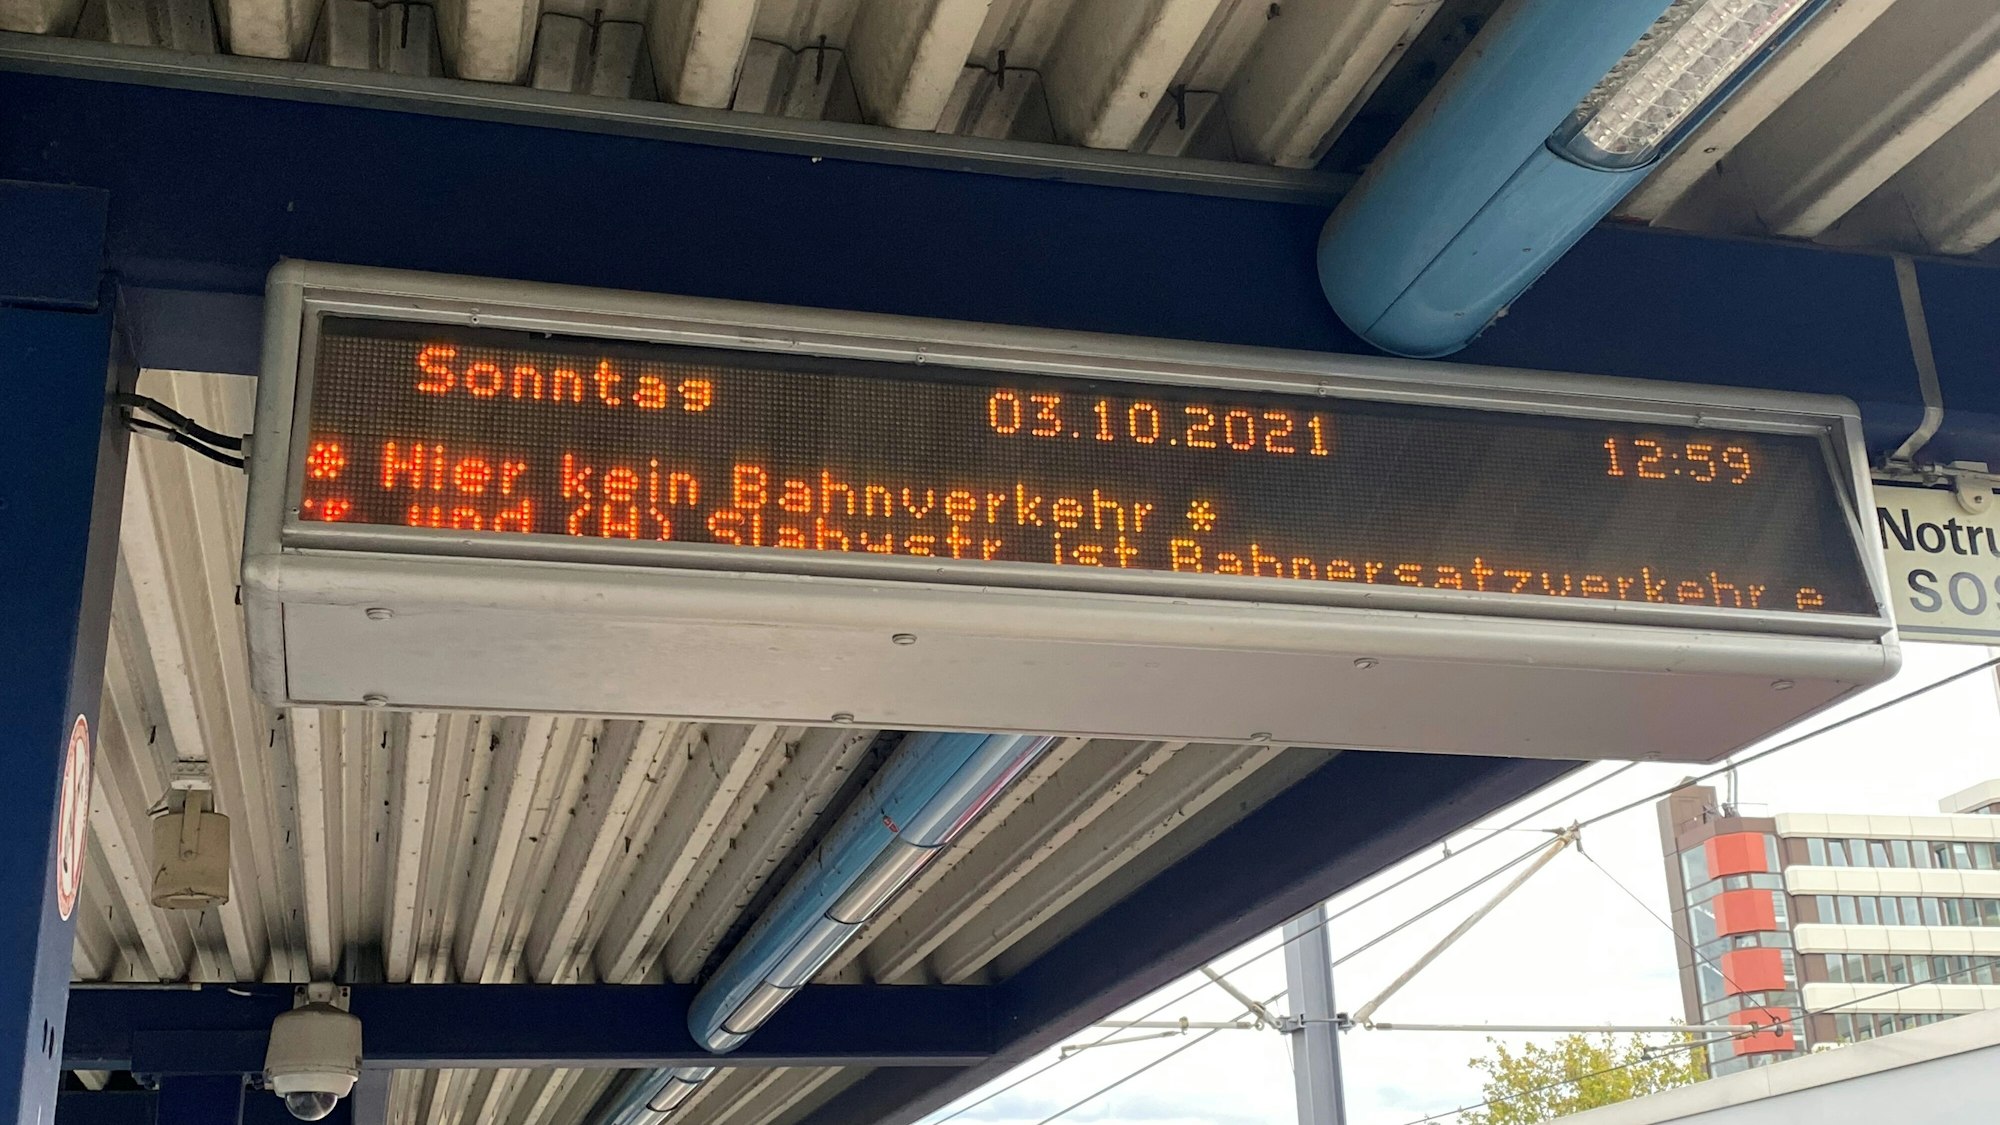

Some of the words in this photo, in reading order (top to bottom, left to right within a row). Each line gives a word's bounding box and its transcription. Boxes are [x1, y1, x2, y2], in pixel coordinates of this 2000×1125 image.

[418, 343, 711, 411] Sonntag
[988, 391, 1329, 456] 03.10.2021
[1603, 437, 1753, 484] 12:59
[382, 440, 527, 495] Hier
[562, 453, 698, 507] kein
[733, 465, 1153, 532] Bahnverkehr
[1907, 568, 2000, 616] SO
